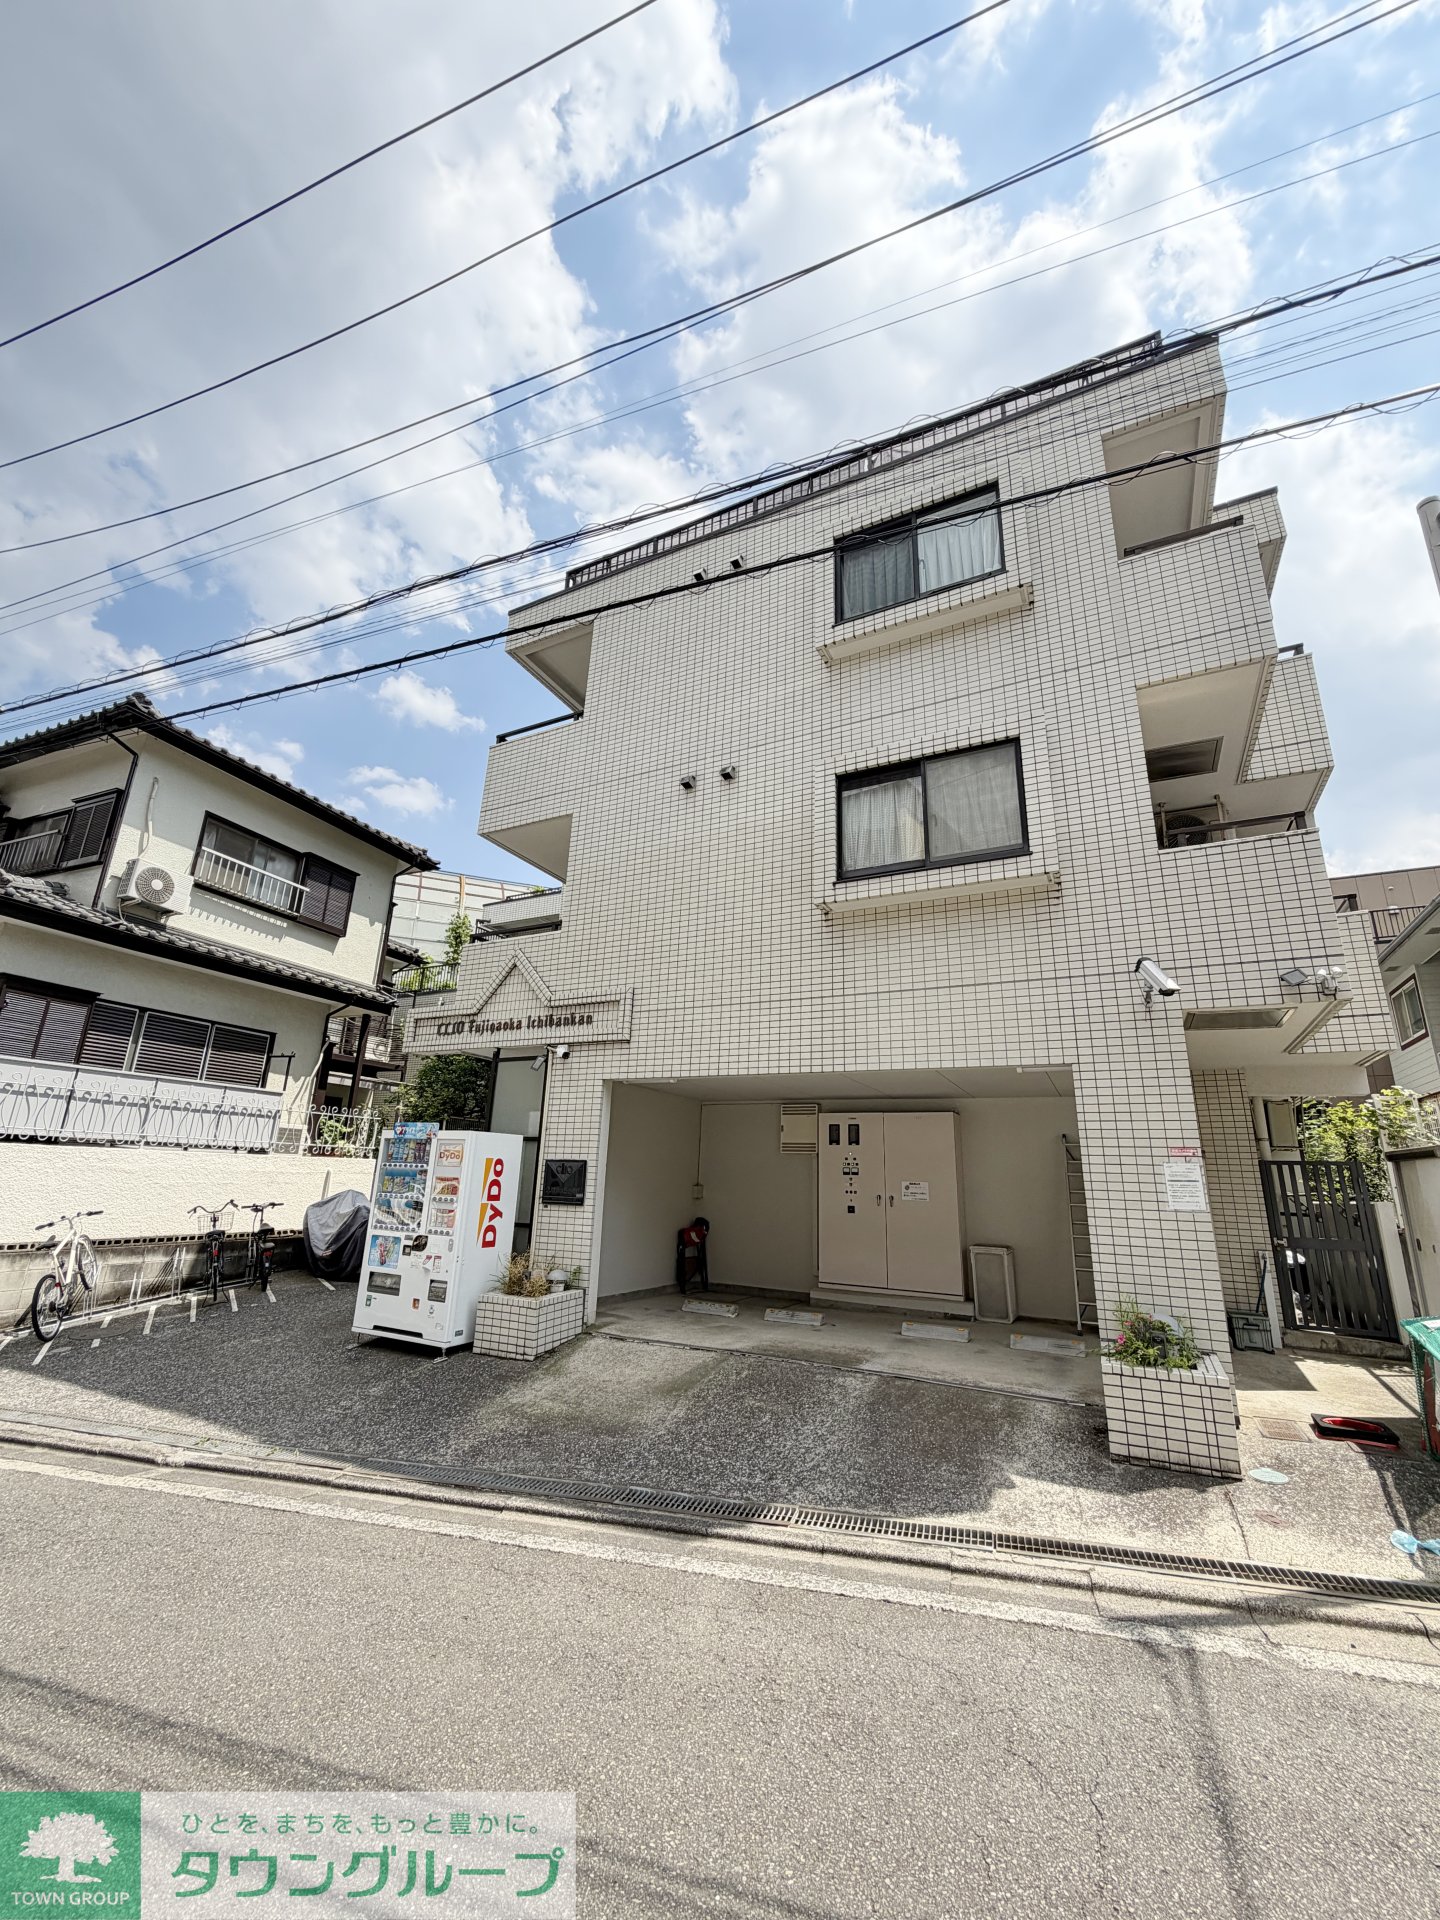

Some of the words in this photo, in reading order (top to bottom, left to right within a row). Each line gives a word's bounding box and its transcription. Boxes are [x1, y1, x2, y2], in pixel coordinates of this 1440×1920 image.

[469, 1018, 522, 1035] Fujigaoka
[527, 1013, 592, 1029] Ichibankan
[439, 1151, 460, 1160] DyDo
[481, 1158, 504, 1248] DyDo
